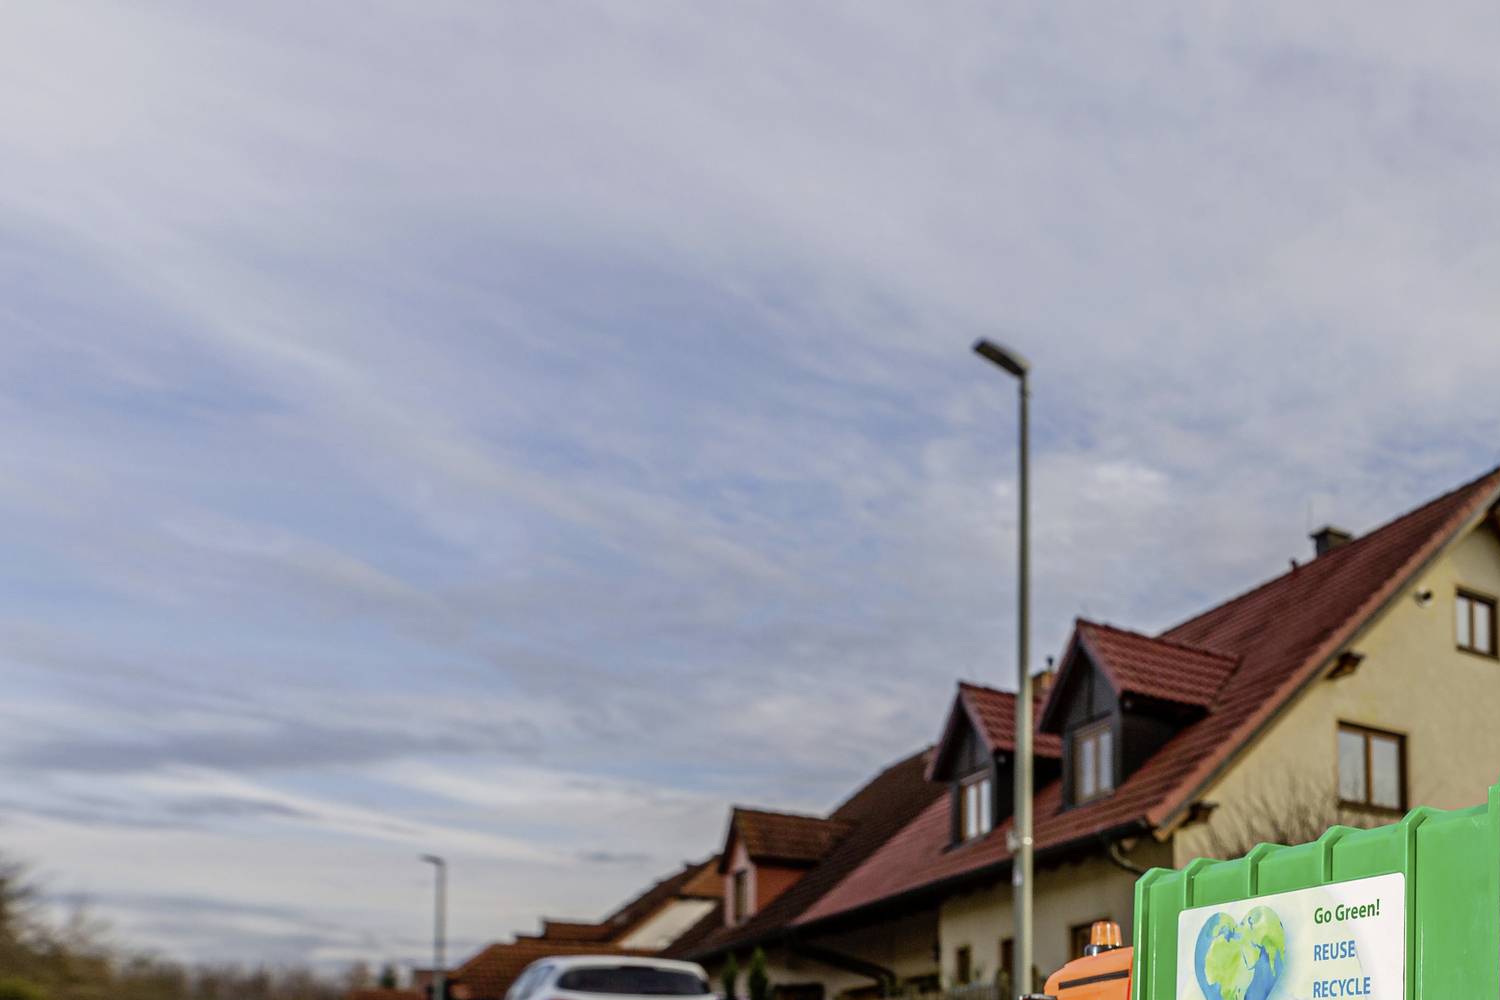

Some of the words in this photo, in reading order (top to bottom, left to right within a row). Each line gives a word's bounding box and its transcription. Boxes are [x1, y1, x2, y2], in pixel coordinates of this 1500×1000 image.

[1314, 907, 1332, 924] Go
[1335, 898, 1380, 921] Green!
[1314, 940, 1356, 961] REUSE
[1313, 976, 1371, 998] RECYCLE
